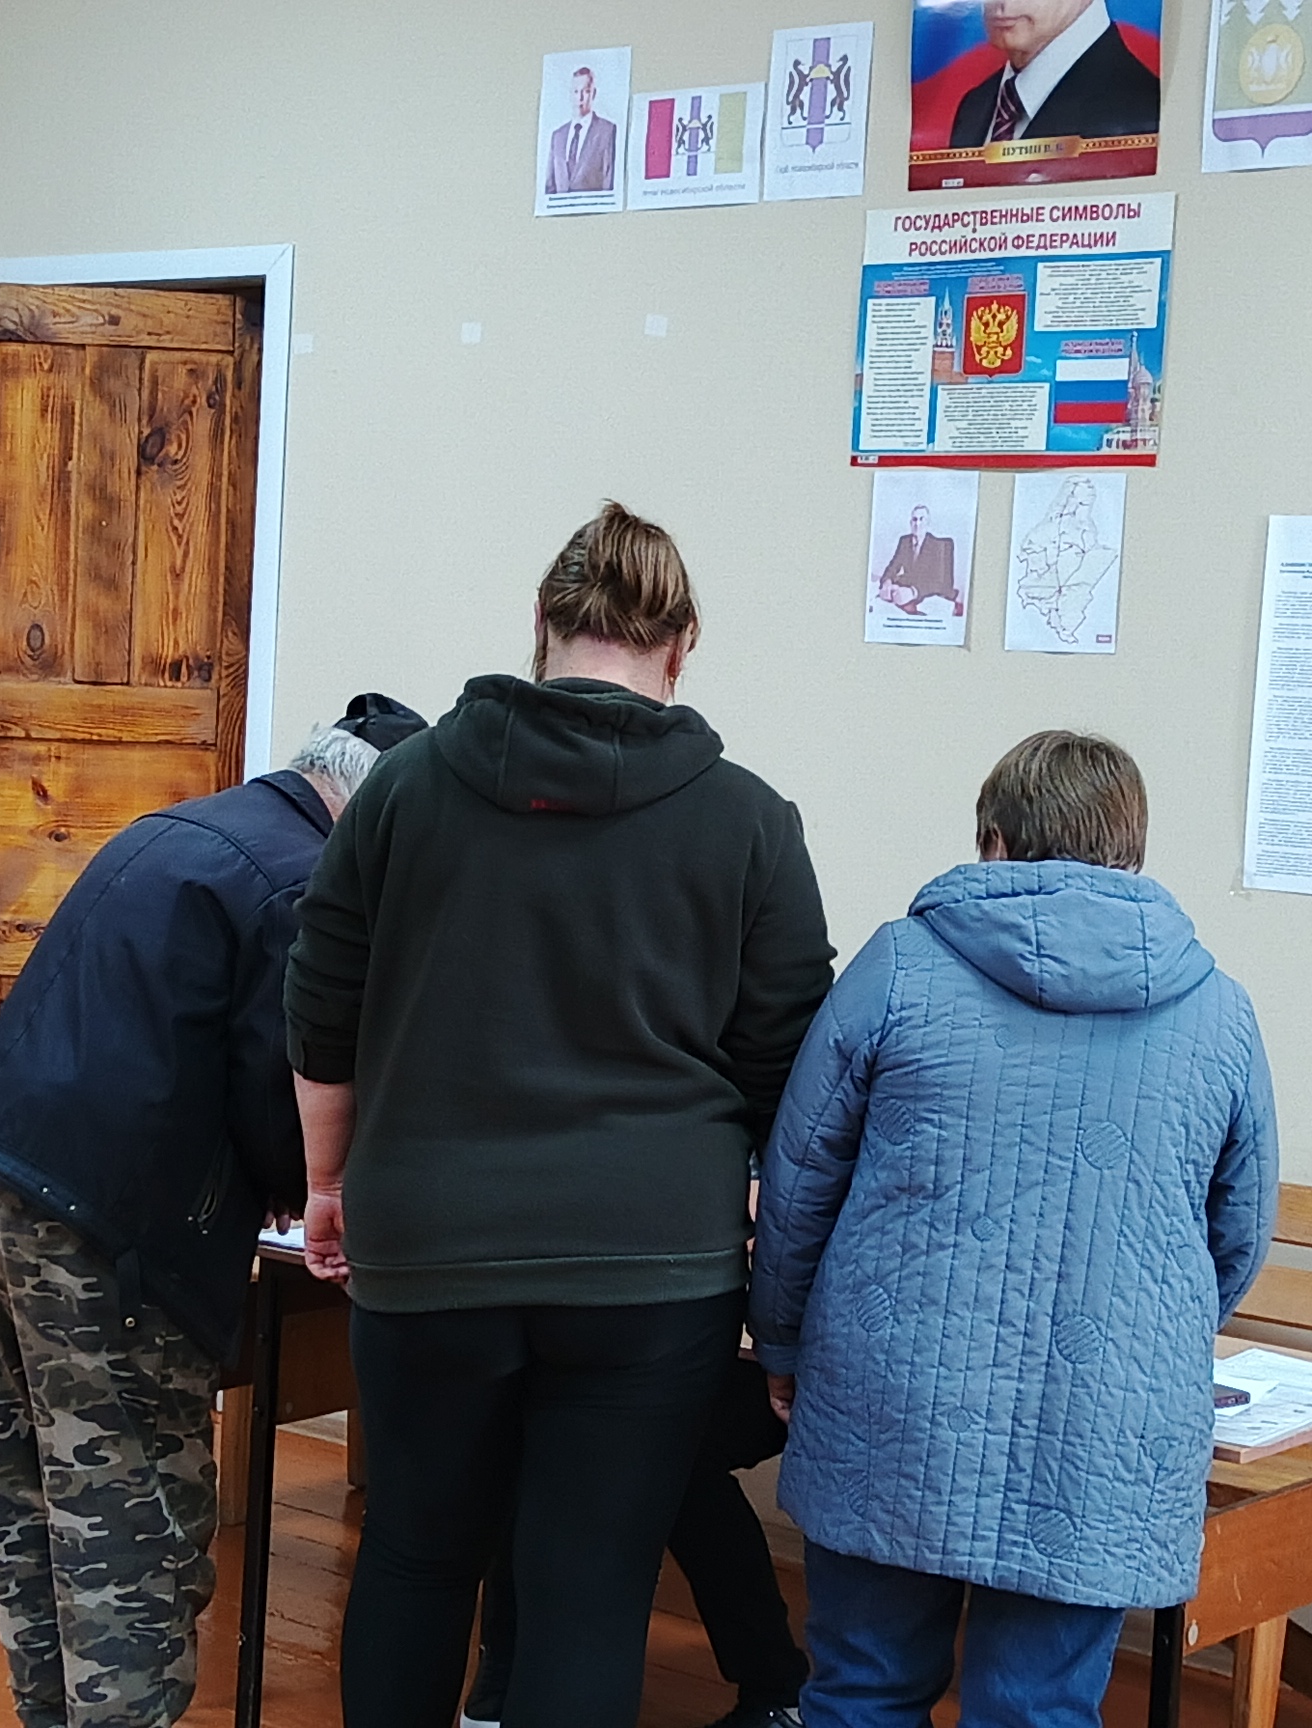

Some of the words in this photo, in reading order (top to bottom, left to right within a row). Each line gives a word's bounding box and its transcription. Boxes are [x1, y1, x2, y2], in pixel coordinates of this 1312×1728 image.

[893, 206, 1045, 233] ГОСУДАРСТВЕННЫЕ
[1049, 202, 1141, 223] СИМВОЛЫ
[908, 233, 1008, 257] РОССИЙСКОЙ
[1011, 231, 1117, 251] ФЕДЕРАЦИИ
